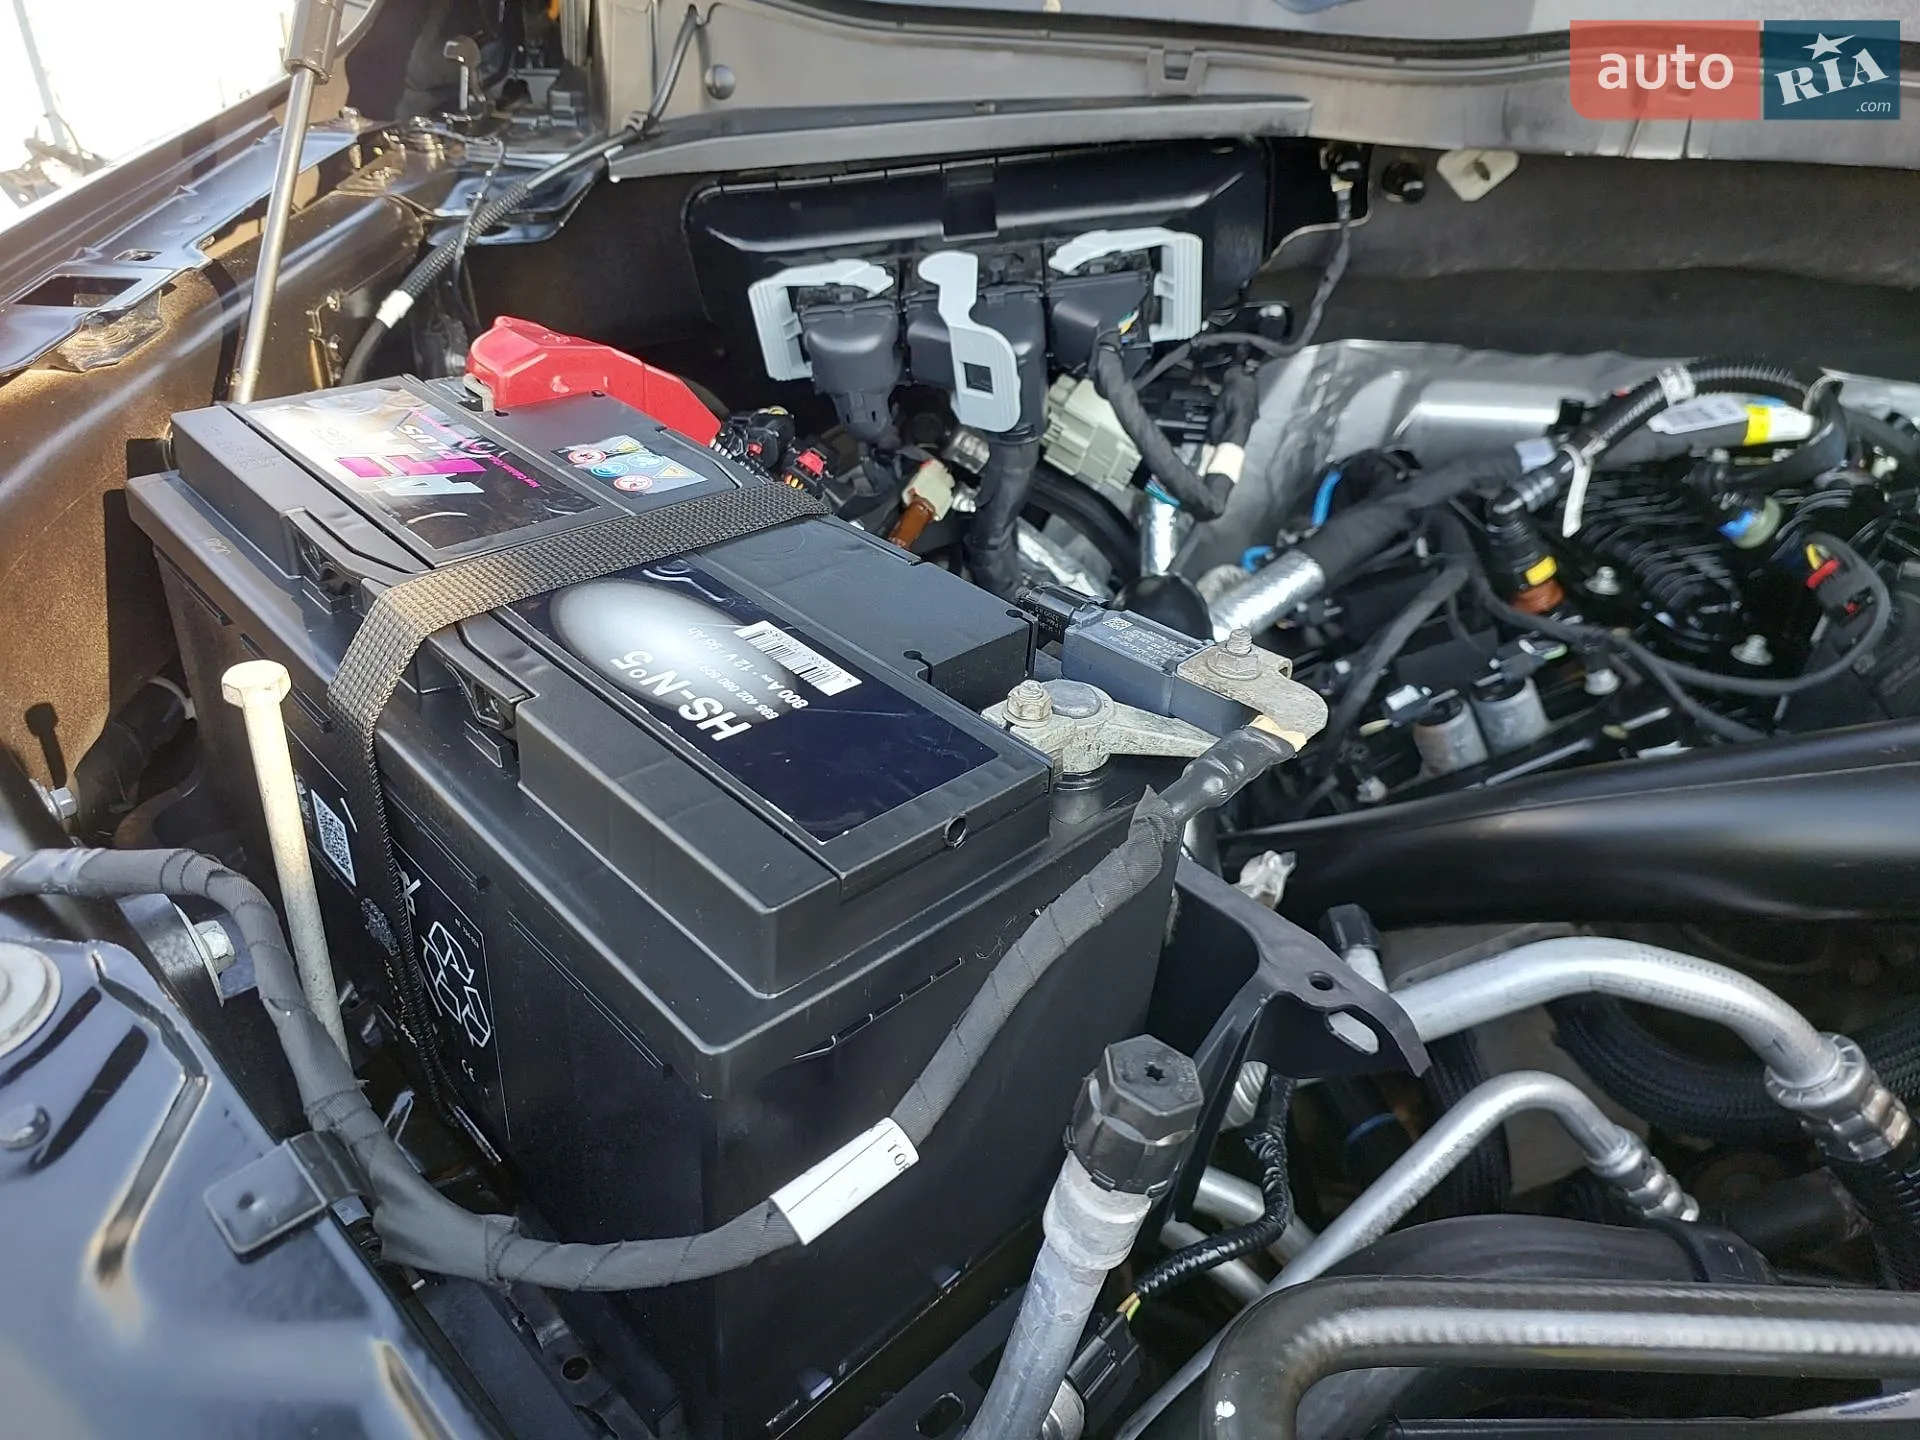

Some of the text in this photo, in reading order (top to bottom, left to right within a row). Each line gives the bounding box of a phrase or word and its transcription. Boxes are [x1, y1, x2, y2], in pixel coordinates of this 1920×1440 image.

[724, 654, 738, 662] V
[733, 659, 754, 671] 12
[736, 690, 759, 705] 402
[778, 690, 809, 709] 800
